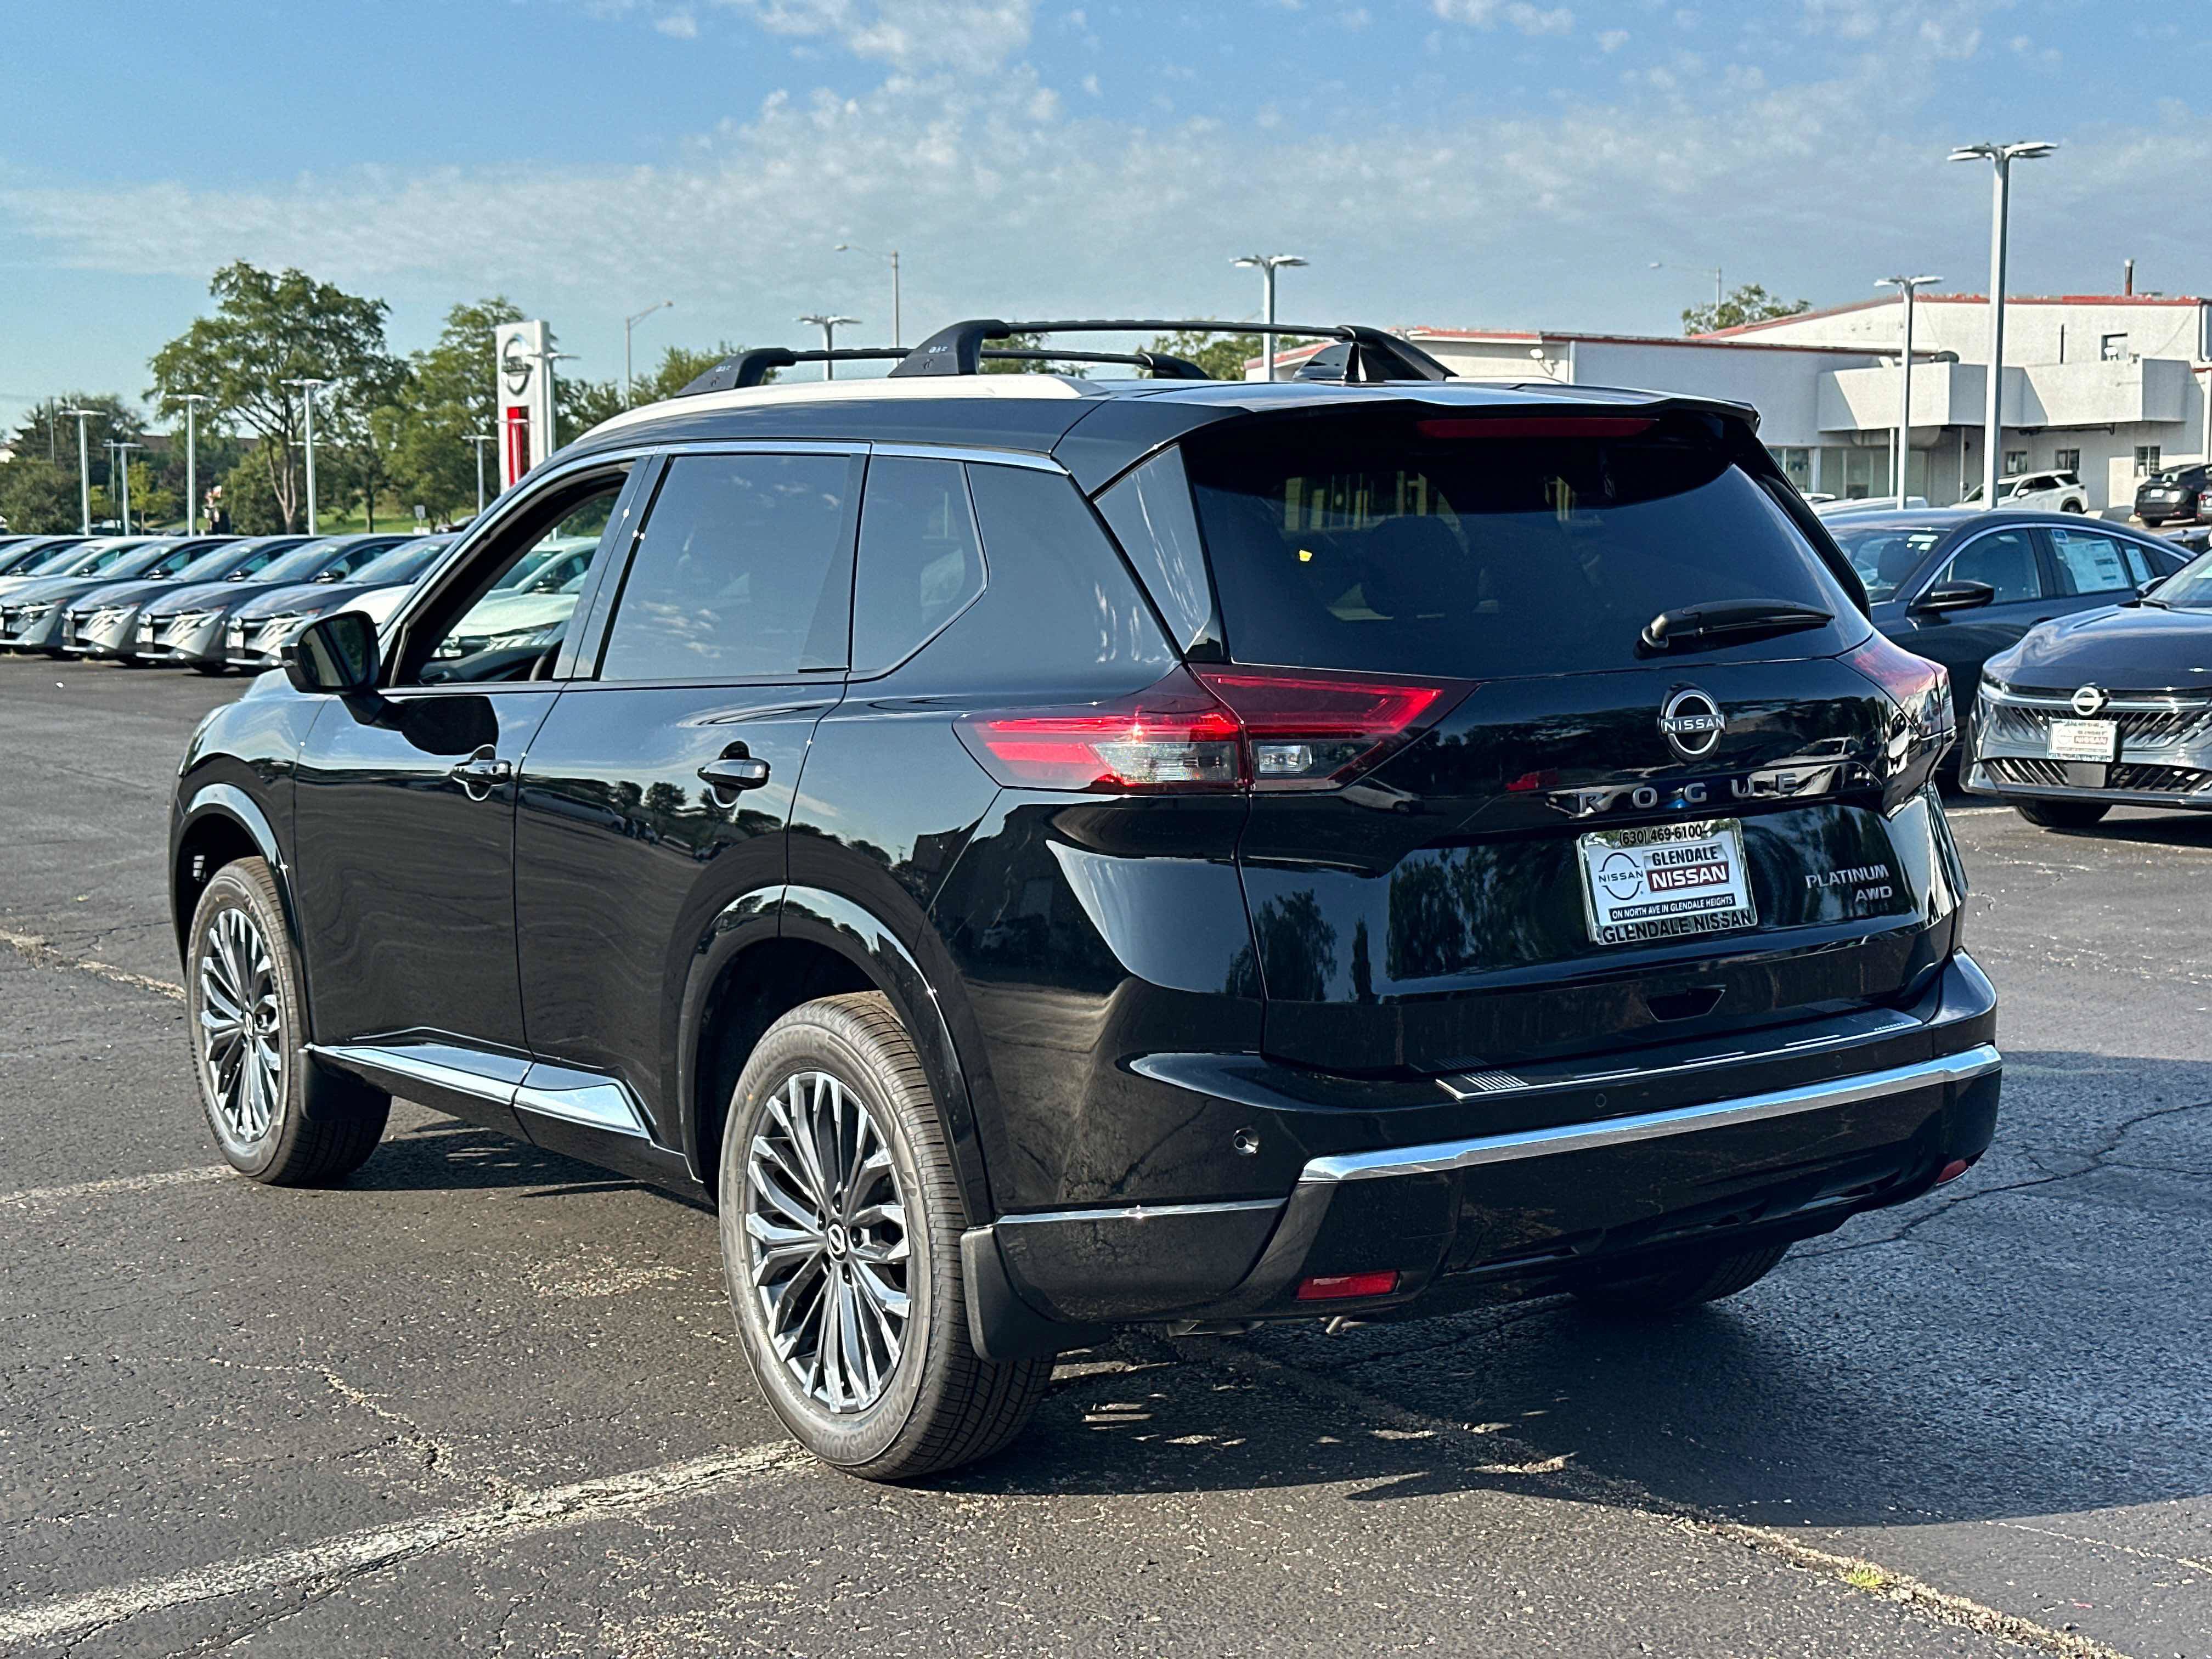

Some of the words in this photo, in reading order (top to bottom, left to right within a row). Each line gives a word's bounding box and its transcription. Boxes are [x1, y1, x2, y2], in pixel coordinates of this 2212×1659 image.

[1664, 716, 1724, 732] NISSAN
[1577, 772, 1798, 812] ROGUE
[1619, 830, 1646, 845] (630)
[1650, 824, 1702, 842] 469-6100
[1651, 845, 1718, 866] GLENDALE
[1598, 869, 1644, 883] NISSAN
[1651, 864, 1728, 889] NISSAN
[1805, 864, 1890, 889] PLATINUM
[1855, 885, 1893, 902] AWD
[1612, 911, 1623, 919] ON
[1624, 907, 1646, 917] NORTH
[1648, 905, 1661, 915] AVE
[1670, 900, 1705, 912] GLENDALE
[1706, 896, 1733, 906] HEIGHTS
[1602, 918, 1690, 943] GLENDALE
[1693, 910, 1752, 932] NISSAN
